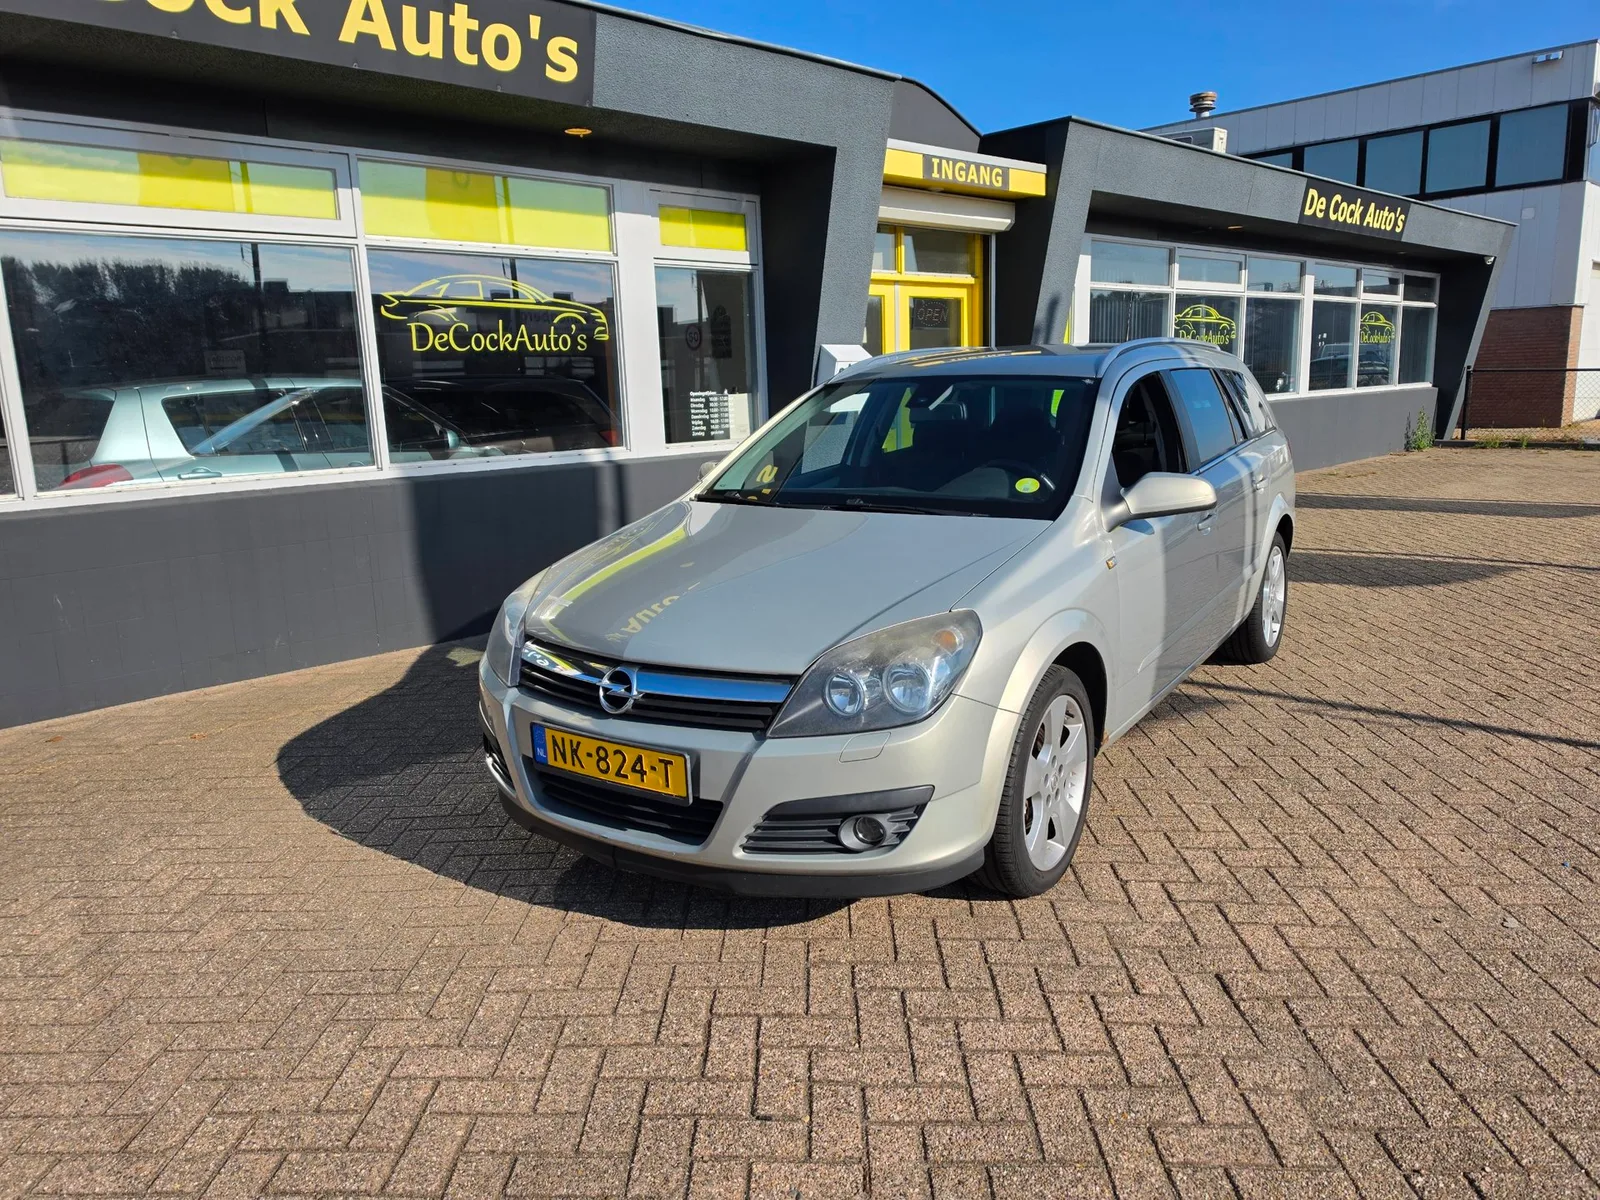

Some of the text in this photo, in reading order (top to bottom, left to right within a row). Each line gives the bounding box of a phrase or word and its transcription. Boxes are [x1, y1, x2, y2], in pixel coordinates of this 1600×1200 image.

[338, 0, 579, 83] Auto's
[931, 158, 1003, 187] INGANG
[1304, 188, 1405, 233] De Cock Auto's
[916, 307, 948, 322] OPEN
[407, 320, 587, 352] DeCockAuto's
[536, 747, 547, 758] NL
[551, 734, 674, 789] NK-824-T
